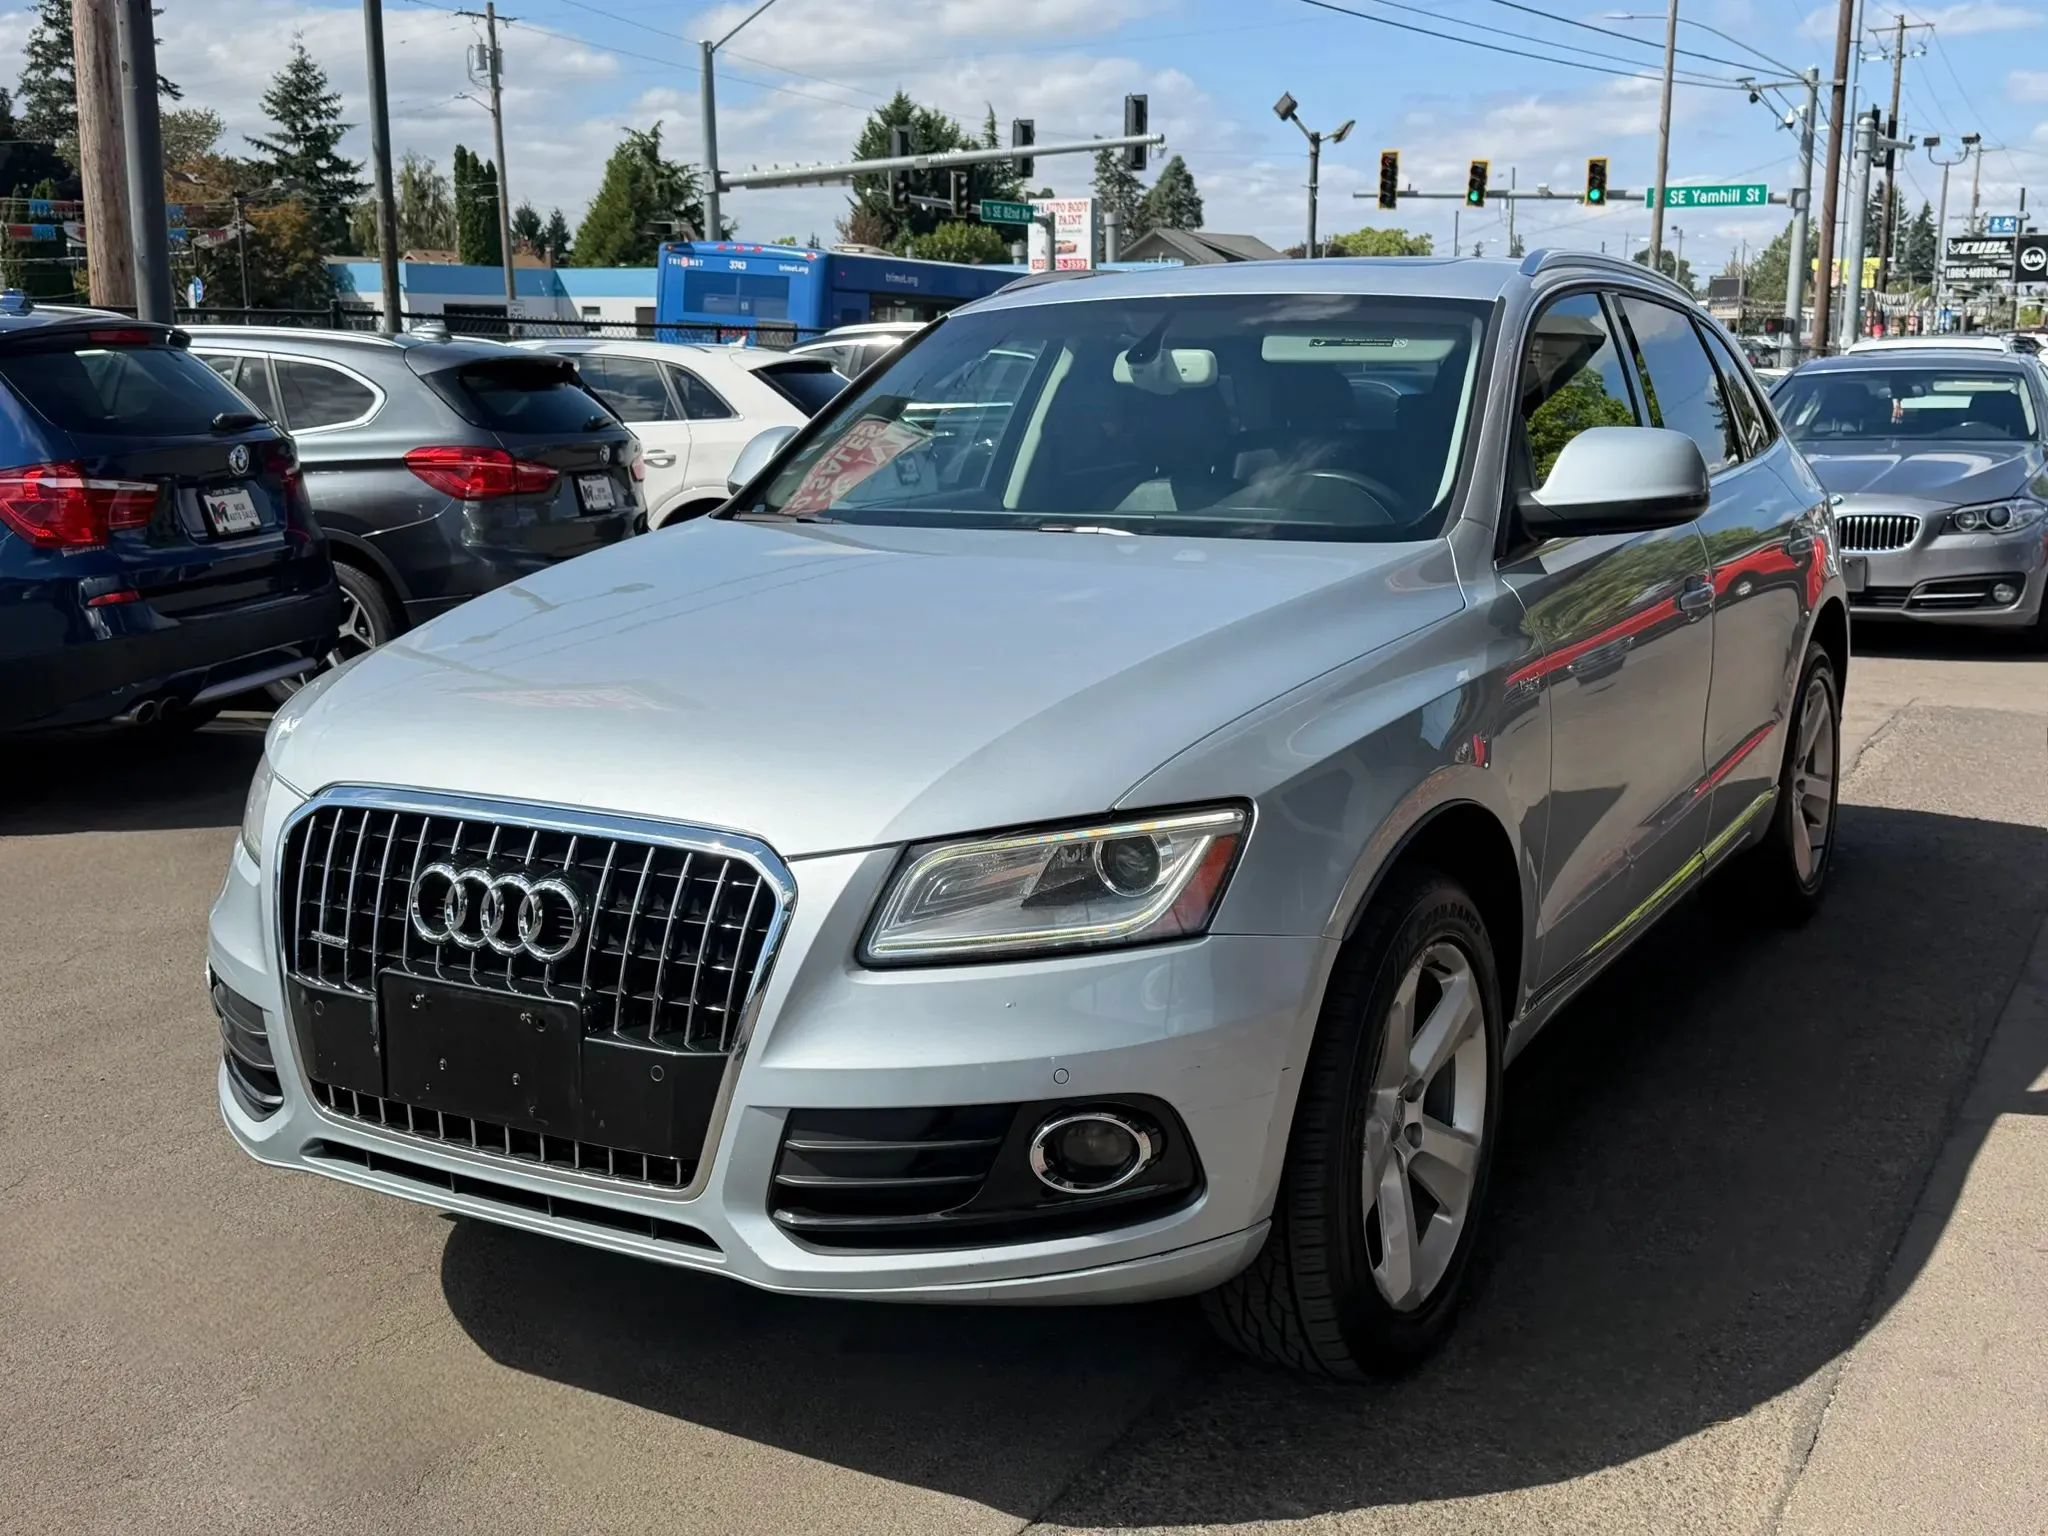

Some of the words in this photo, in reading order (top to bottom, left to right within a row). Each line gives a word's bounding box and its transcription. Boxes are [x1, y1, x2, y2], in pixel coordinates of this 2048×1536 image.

[1669, 190, 1686, 204] SE
[1692, 188, 1740, 204] Yamhill
[1746, 187, 1760, 202] St
[993, 206, 1001, 218] SE
[1058, 215, 1082, 225] PAINT
